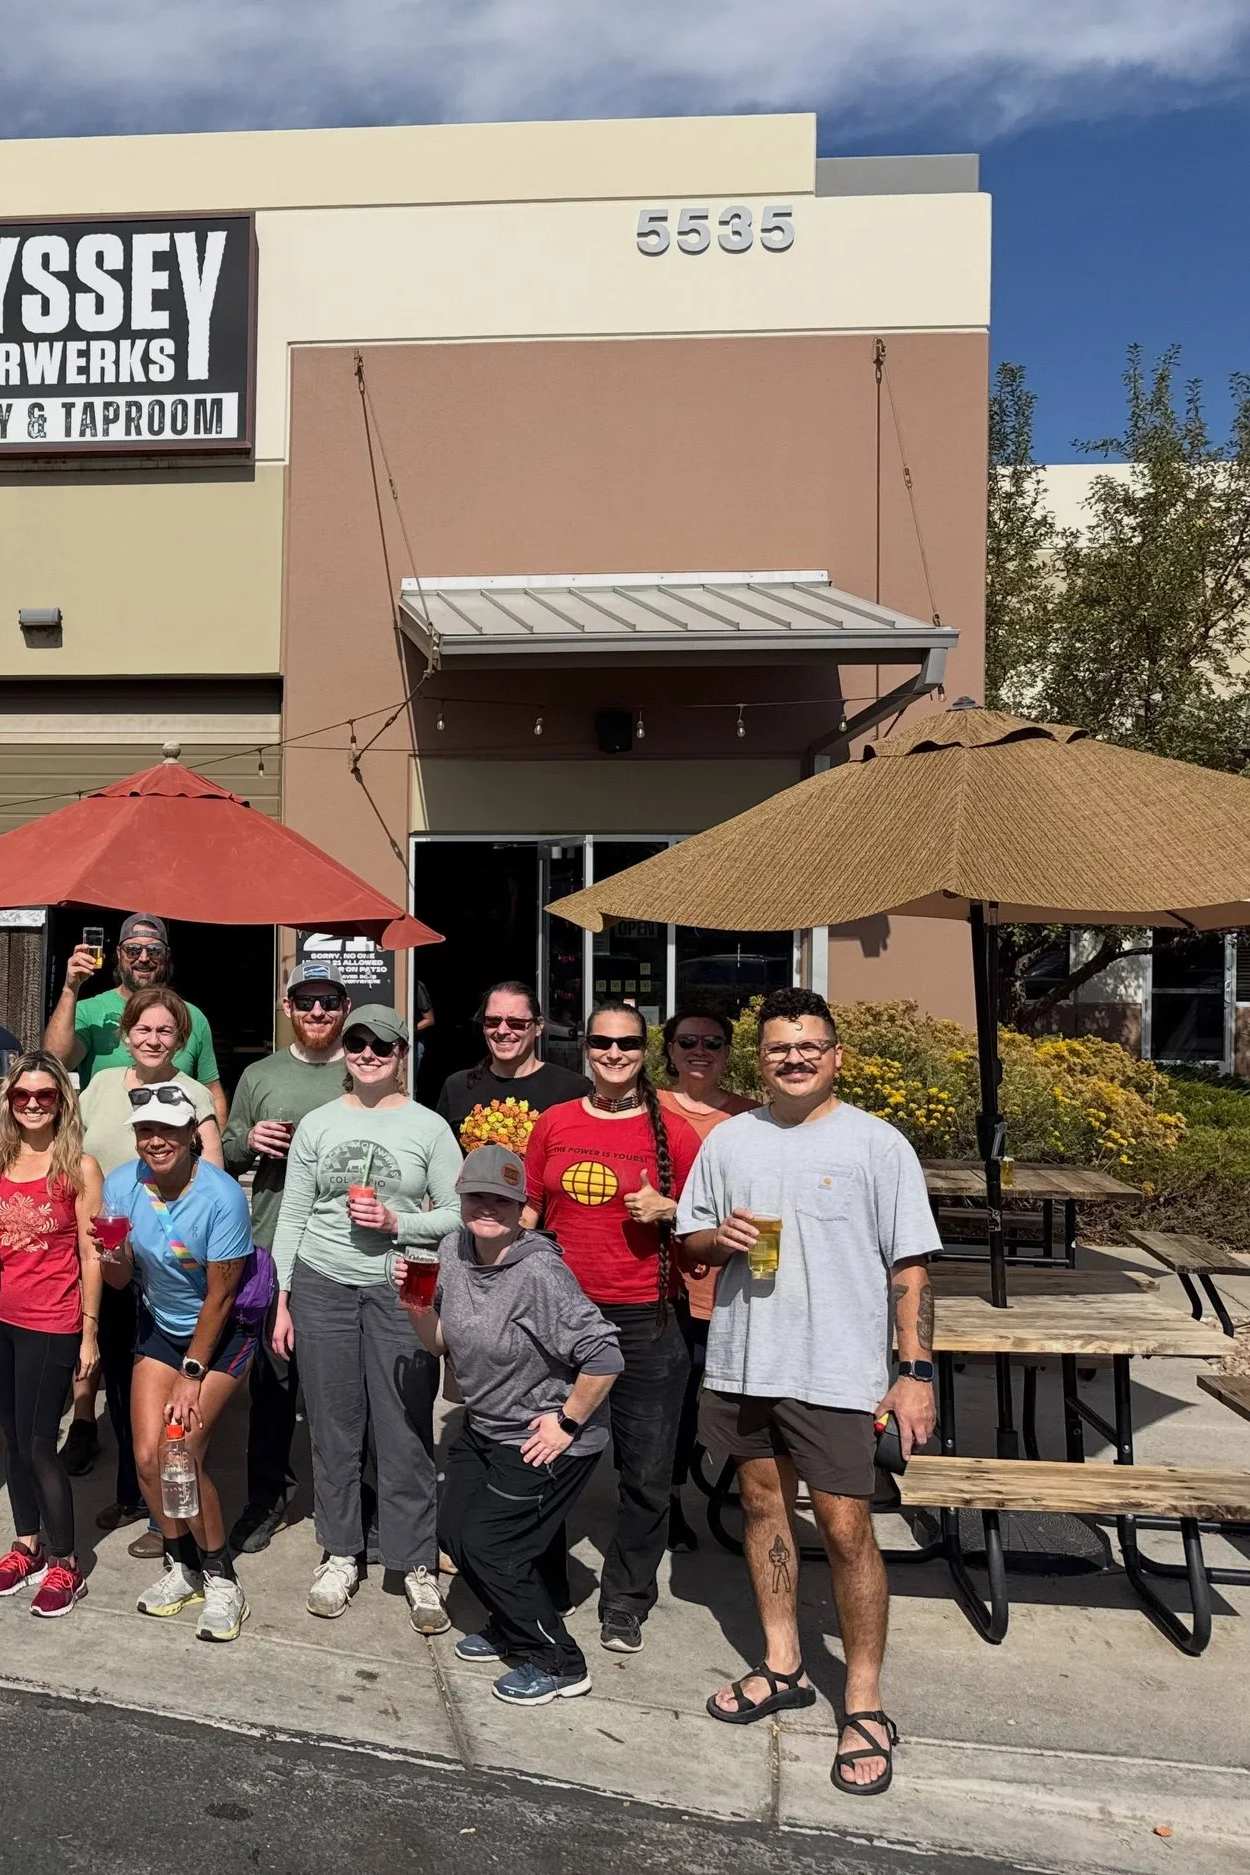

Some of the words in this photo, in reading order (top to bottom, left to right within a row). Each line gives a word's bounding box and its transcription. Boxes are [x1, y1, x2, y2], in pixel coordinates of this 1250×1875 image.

[636, 204, 795, 256] 5535
[27, 402, 47, 439] &
[61, 398, 224, 438] TAPROOM
[569, 1146, 600, 1157] POWER
